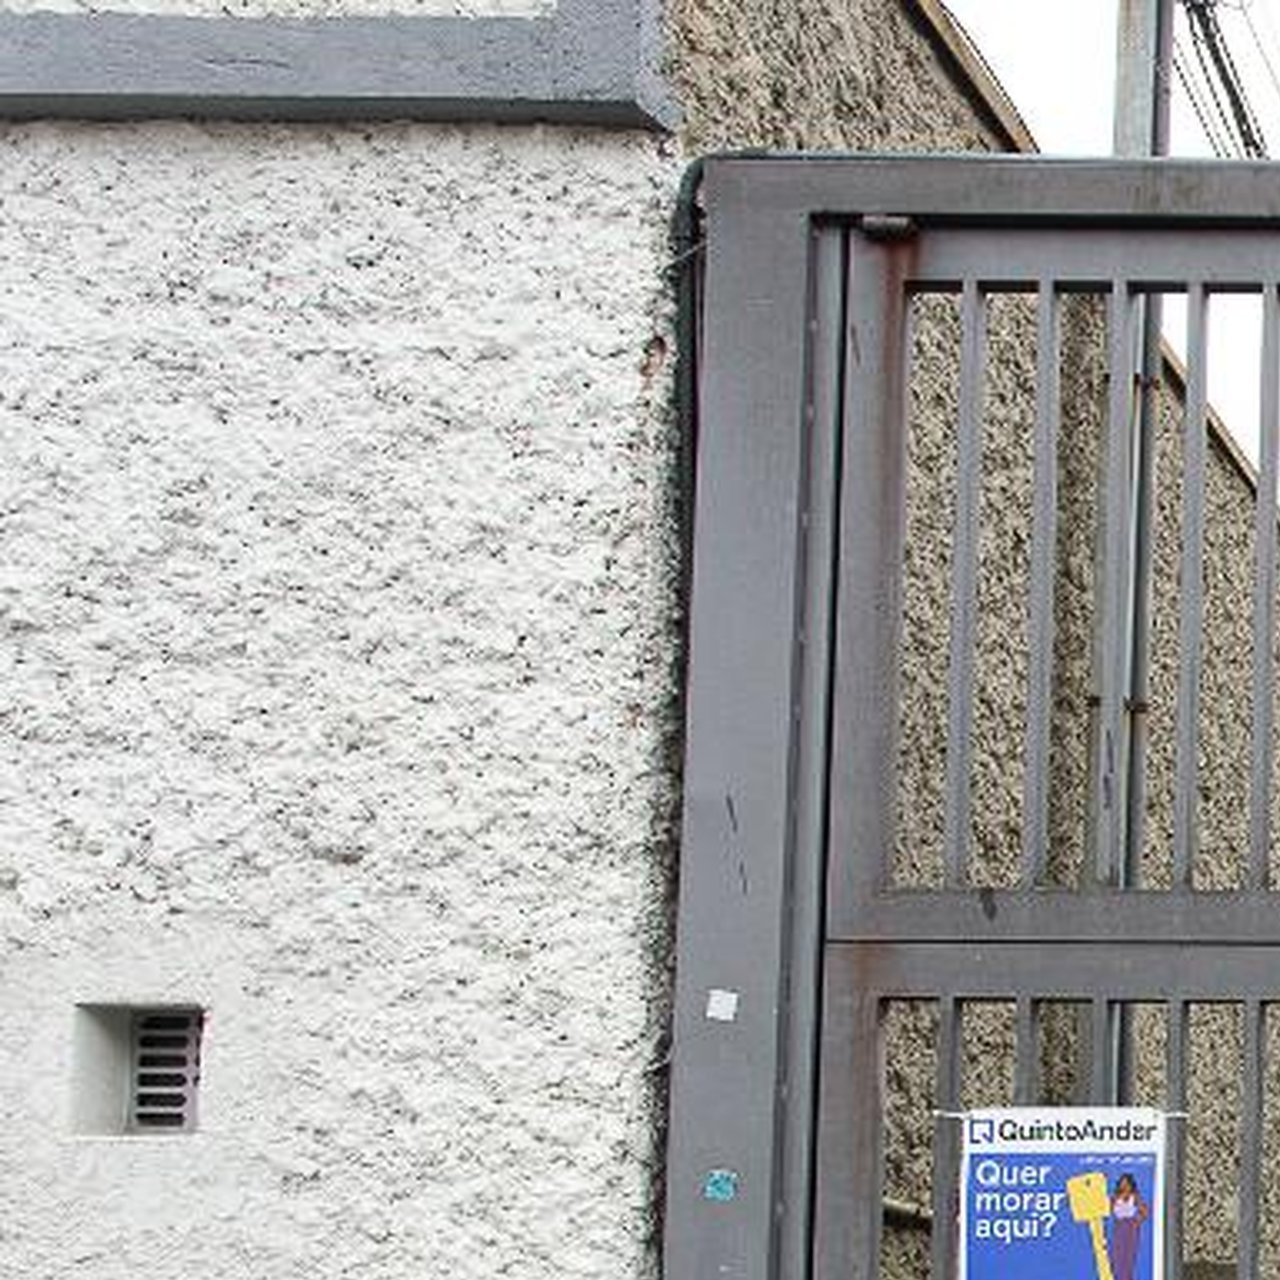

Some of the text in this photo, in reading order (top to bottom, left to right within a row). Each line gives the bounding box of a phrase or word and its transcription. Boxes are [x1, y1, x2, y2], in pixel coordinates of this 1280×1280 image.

[975, 1160, 1052, 1186] Quer
[975, 1192, 1066, 1212] morar
[975, 1214, 1058, 1244] aqui?
